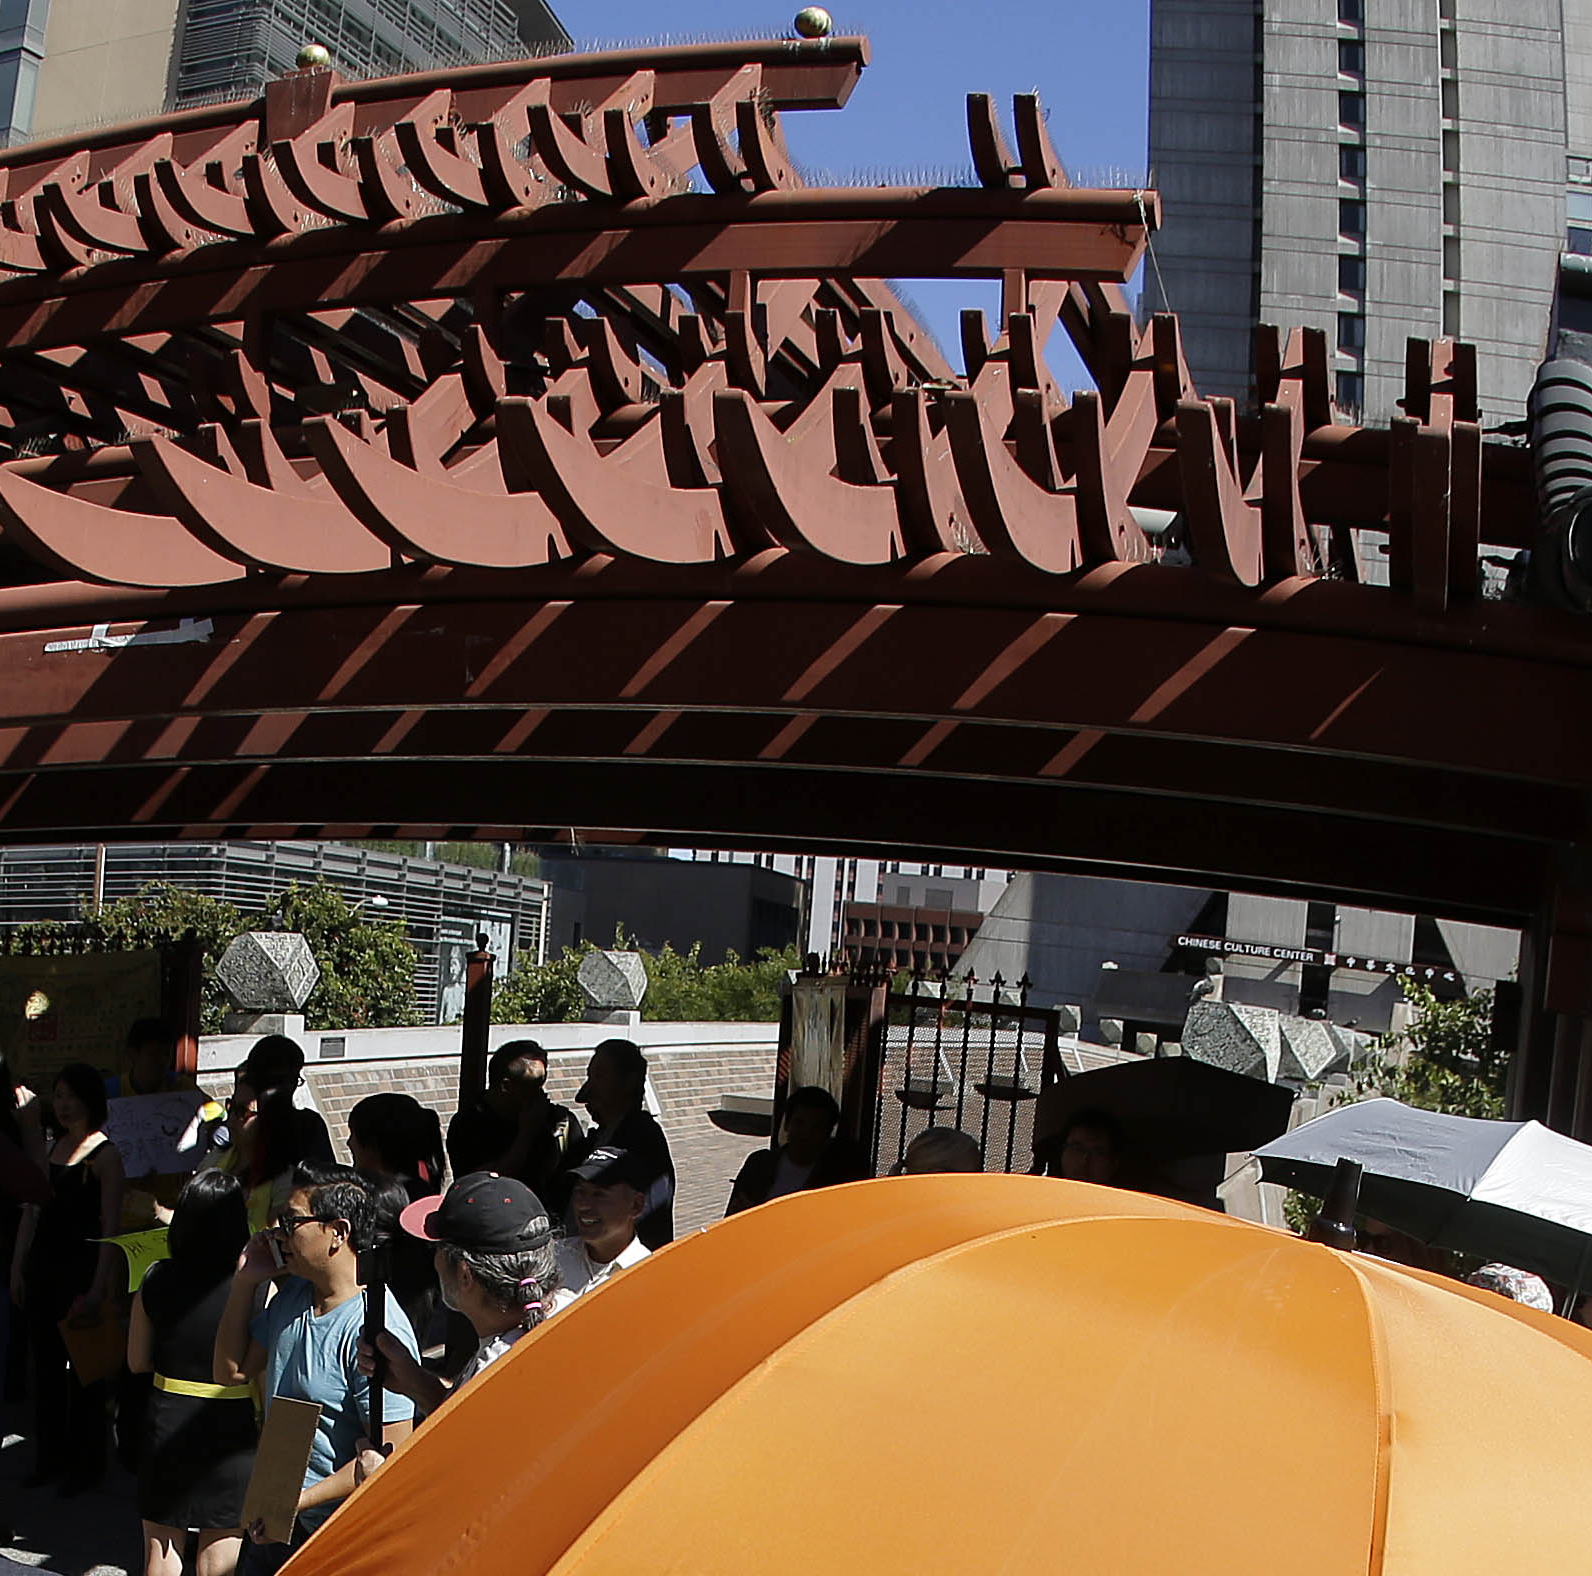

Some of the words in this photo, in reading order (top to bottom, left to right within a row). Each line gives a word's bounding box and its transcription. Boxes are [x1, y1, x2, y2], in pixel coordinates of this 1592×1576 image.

[1177, 935, 1222, 951] CHINESE
[1224, 941, 1271, 957] CULTURE
[1273, 948, 1314, 962] CENTER
